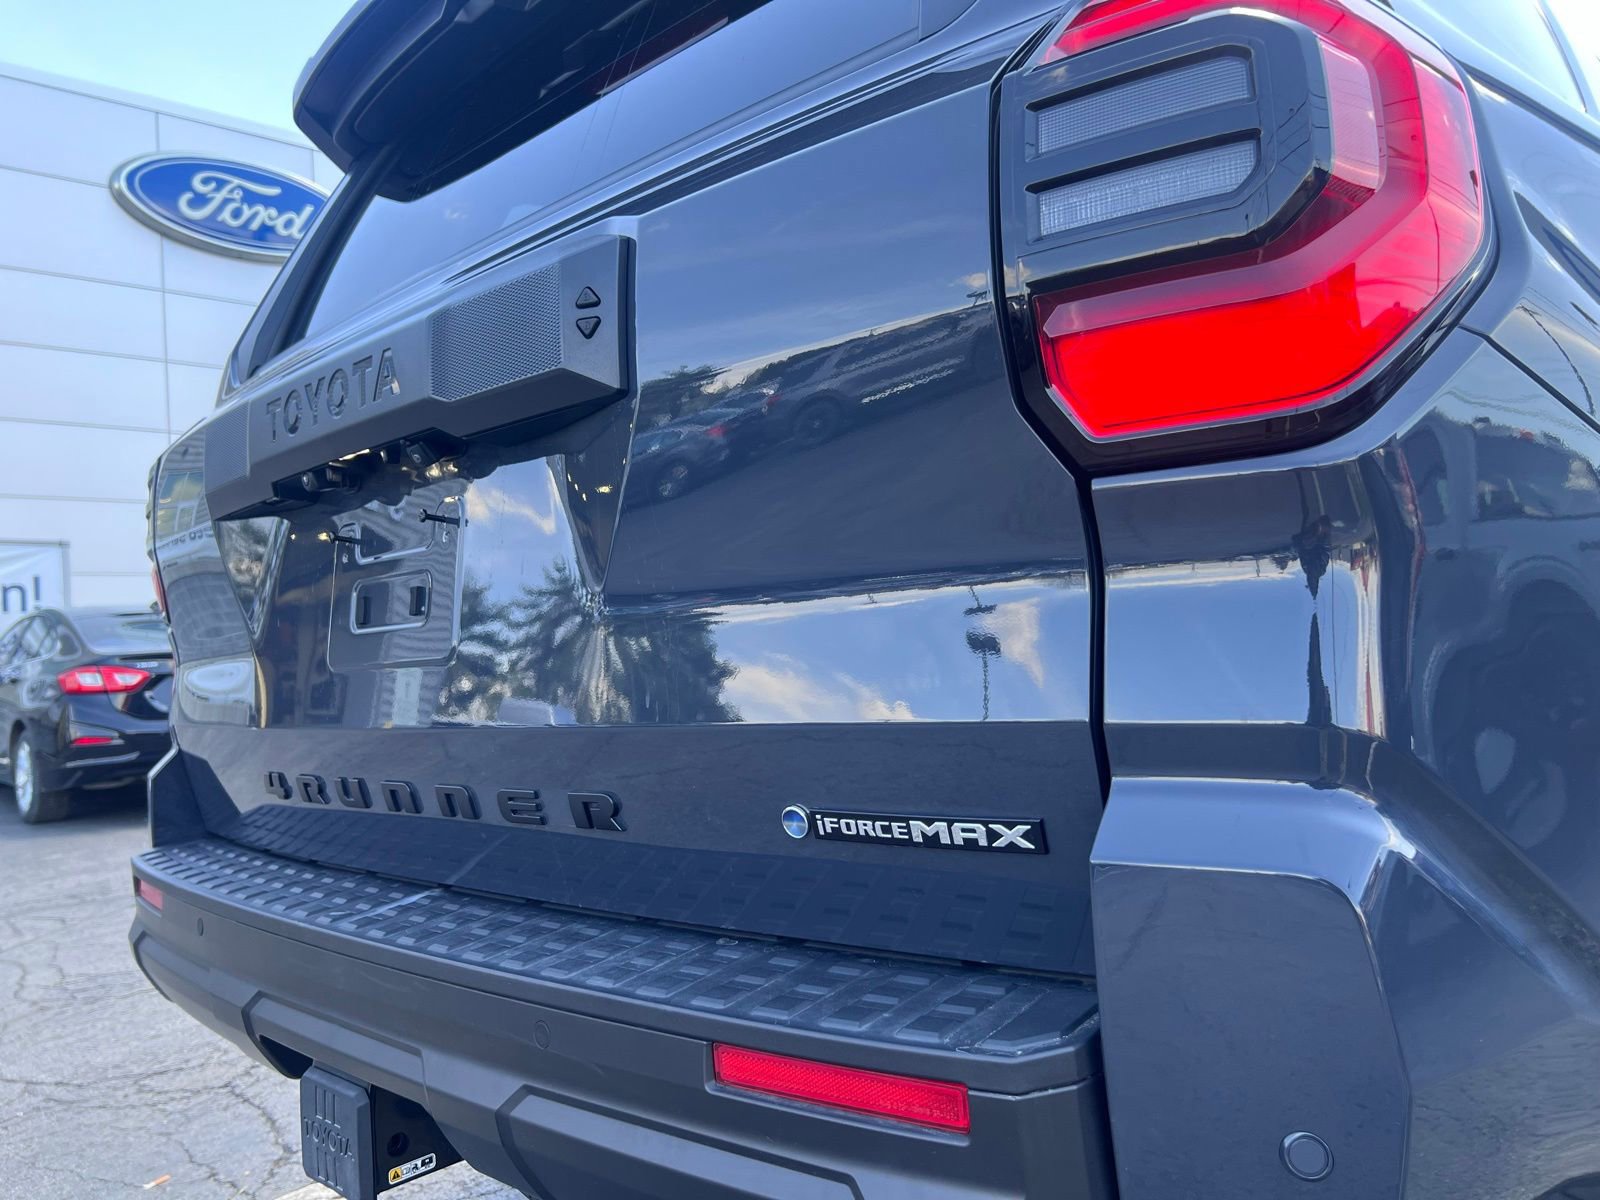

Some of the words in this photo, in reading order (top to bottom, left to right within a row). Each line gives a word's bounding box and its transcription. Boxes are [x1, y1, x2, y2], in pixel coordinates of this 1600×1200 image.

[178, 168, 315, 239] Ford
[265, 347, 401, 442] TOYOTA
[264, 771, 627, 832] 4RUNNER
[303, 1116, 355, 1161] TOYOTA
